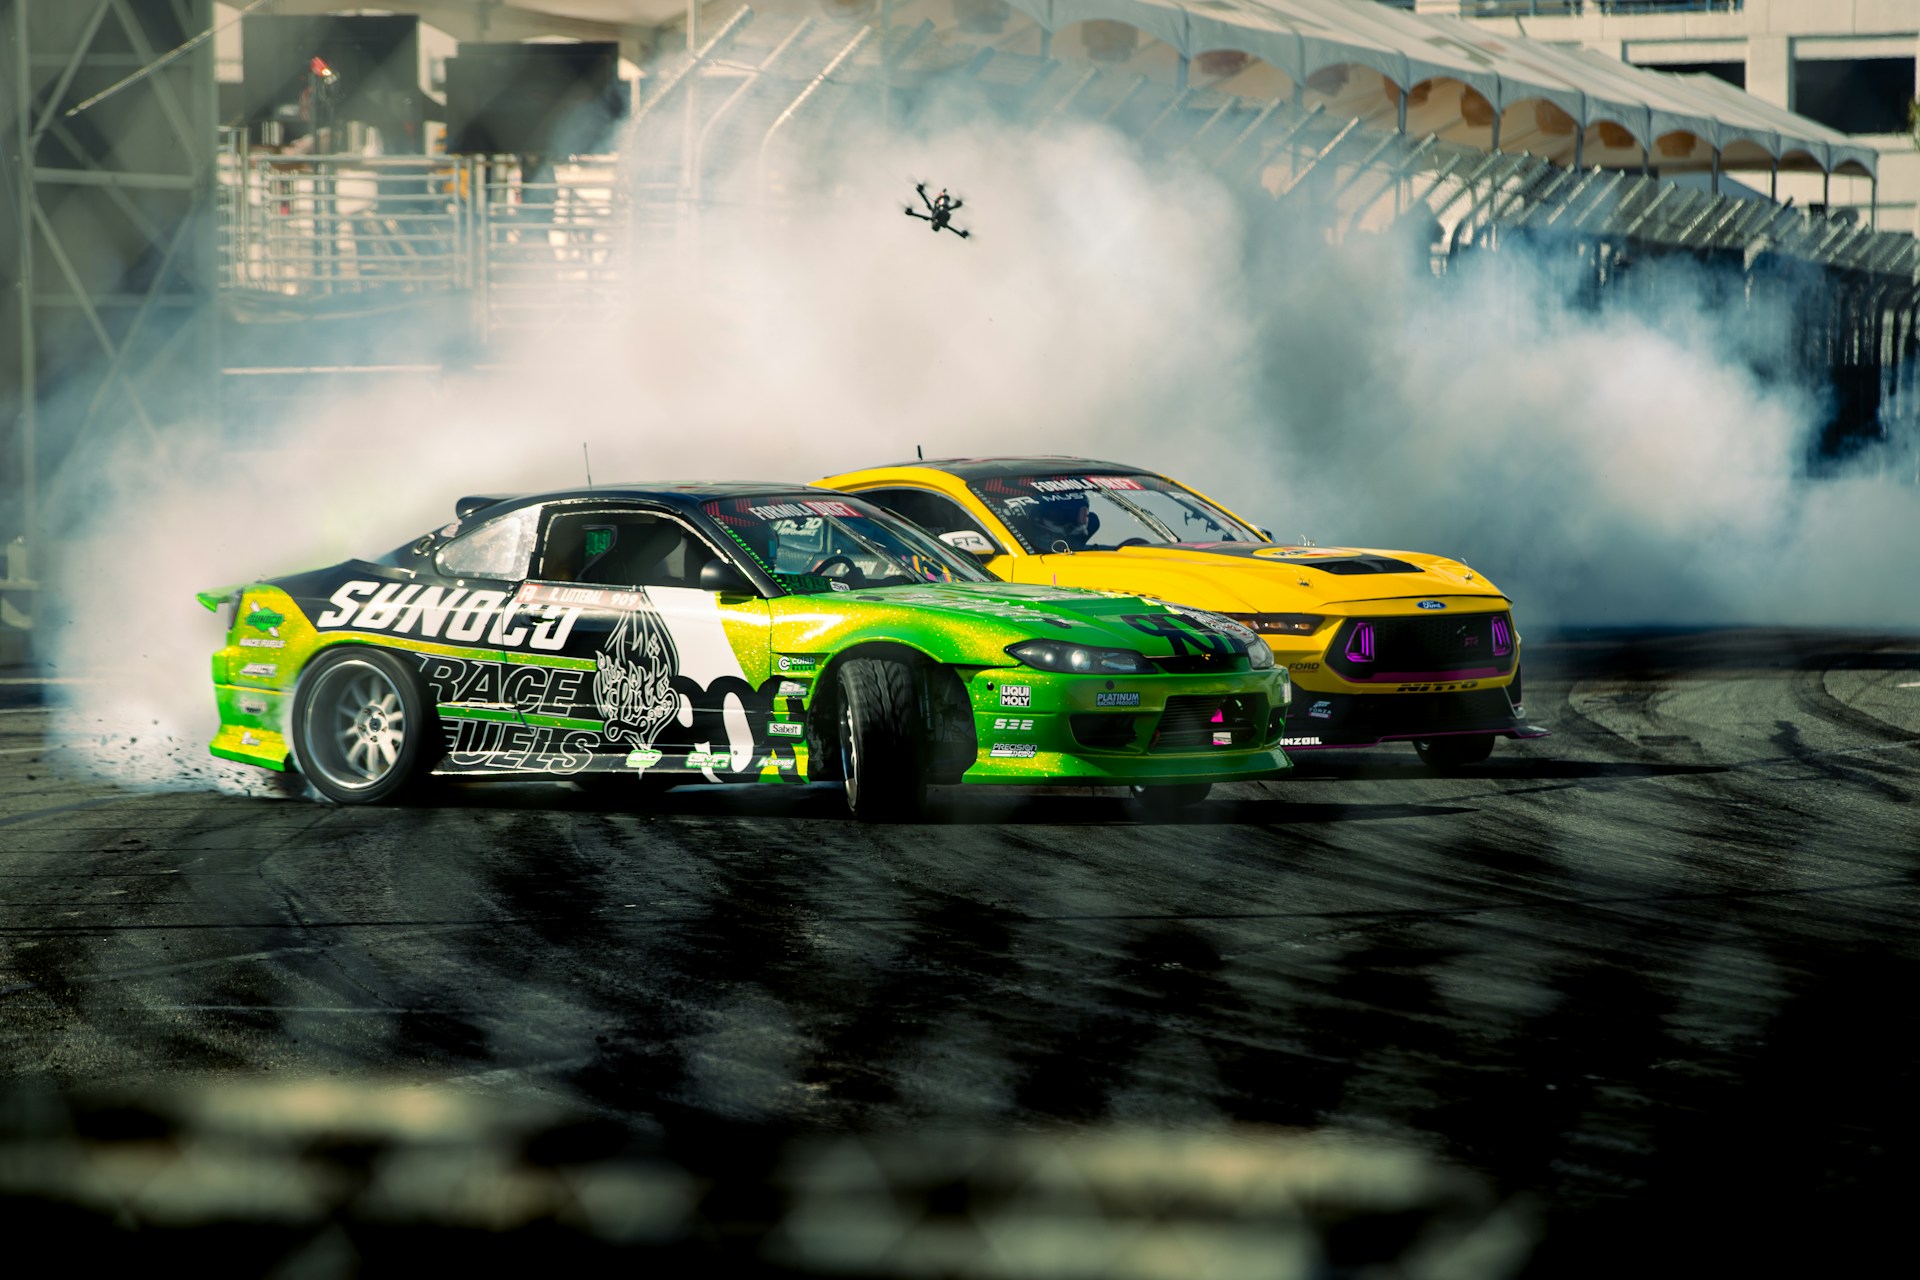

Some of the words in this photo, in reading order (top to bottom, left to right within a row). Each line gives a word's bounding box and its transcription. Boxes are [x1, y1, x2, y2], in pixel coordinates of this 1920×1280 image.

[1030, 479, 1098, 492] FORMULA
[1090, 477, 1141, 490] DRIFT
[748, 504, 818, 521] FORMULA
[803, 502, 859, 517] DRIFT
[611, 592, 639, 607] 909
[317, 580, 582, 651] SUNOCO
[416, 653, 583, 716] RACE
[1397, 681, 1478, 691] NITTO
[1002, 686, 1030, 695] LIQUI
[1002, 696, 1030, 705] MOLY
[1097, 693, 1139, 702] PLATINUM
[773, 724, 798, 734] Sabelt
[1279, 737, 1322, 746] NZOIL
